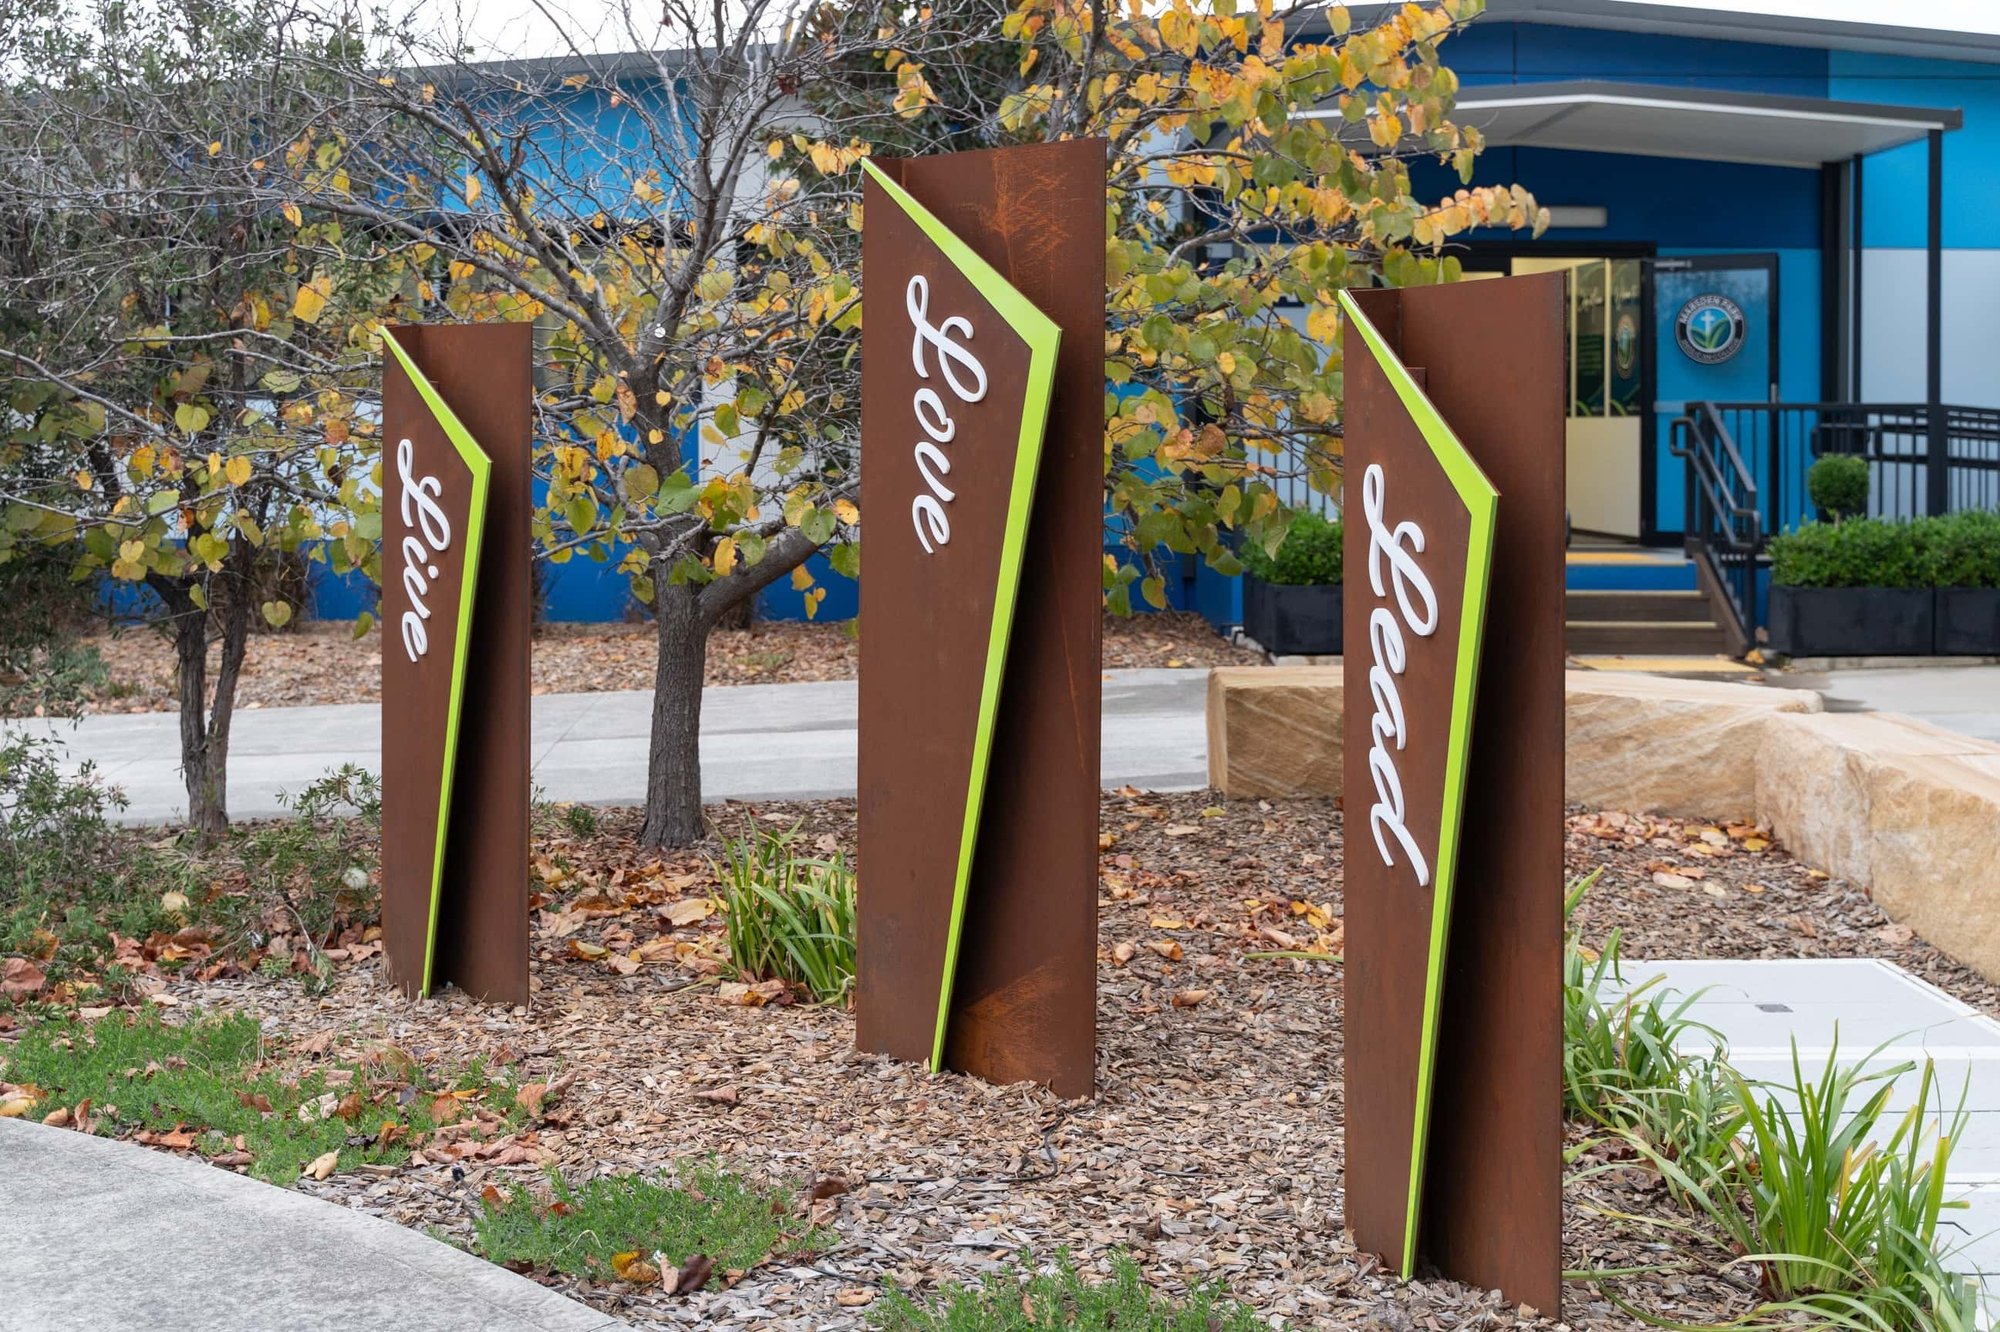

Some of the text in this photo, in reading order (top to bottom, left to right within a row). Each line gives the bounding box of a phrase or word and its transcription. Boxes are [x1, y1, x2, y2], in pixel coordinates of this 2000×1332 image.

[906, 274, 989, 555] Love
[1678, 295, 1743, 324] MARSDEN PARK
[396, 437, 452, 663] Live
[1362, 463, 1440, 888] Lead
